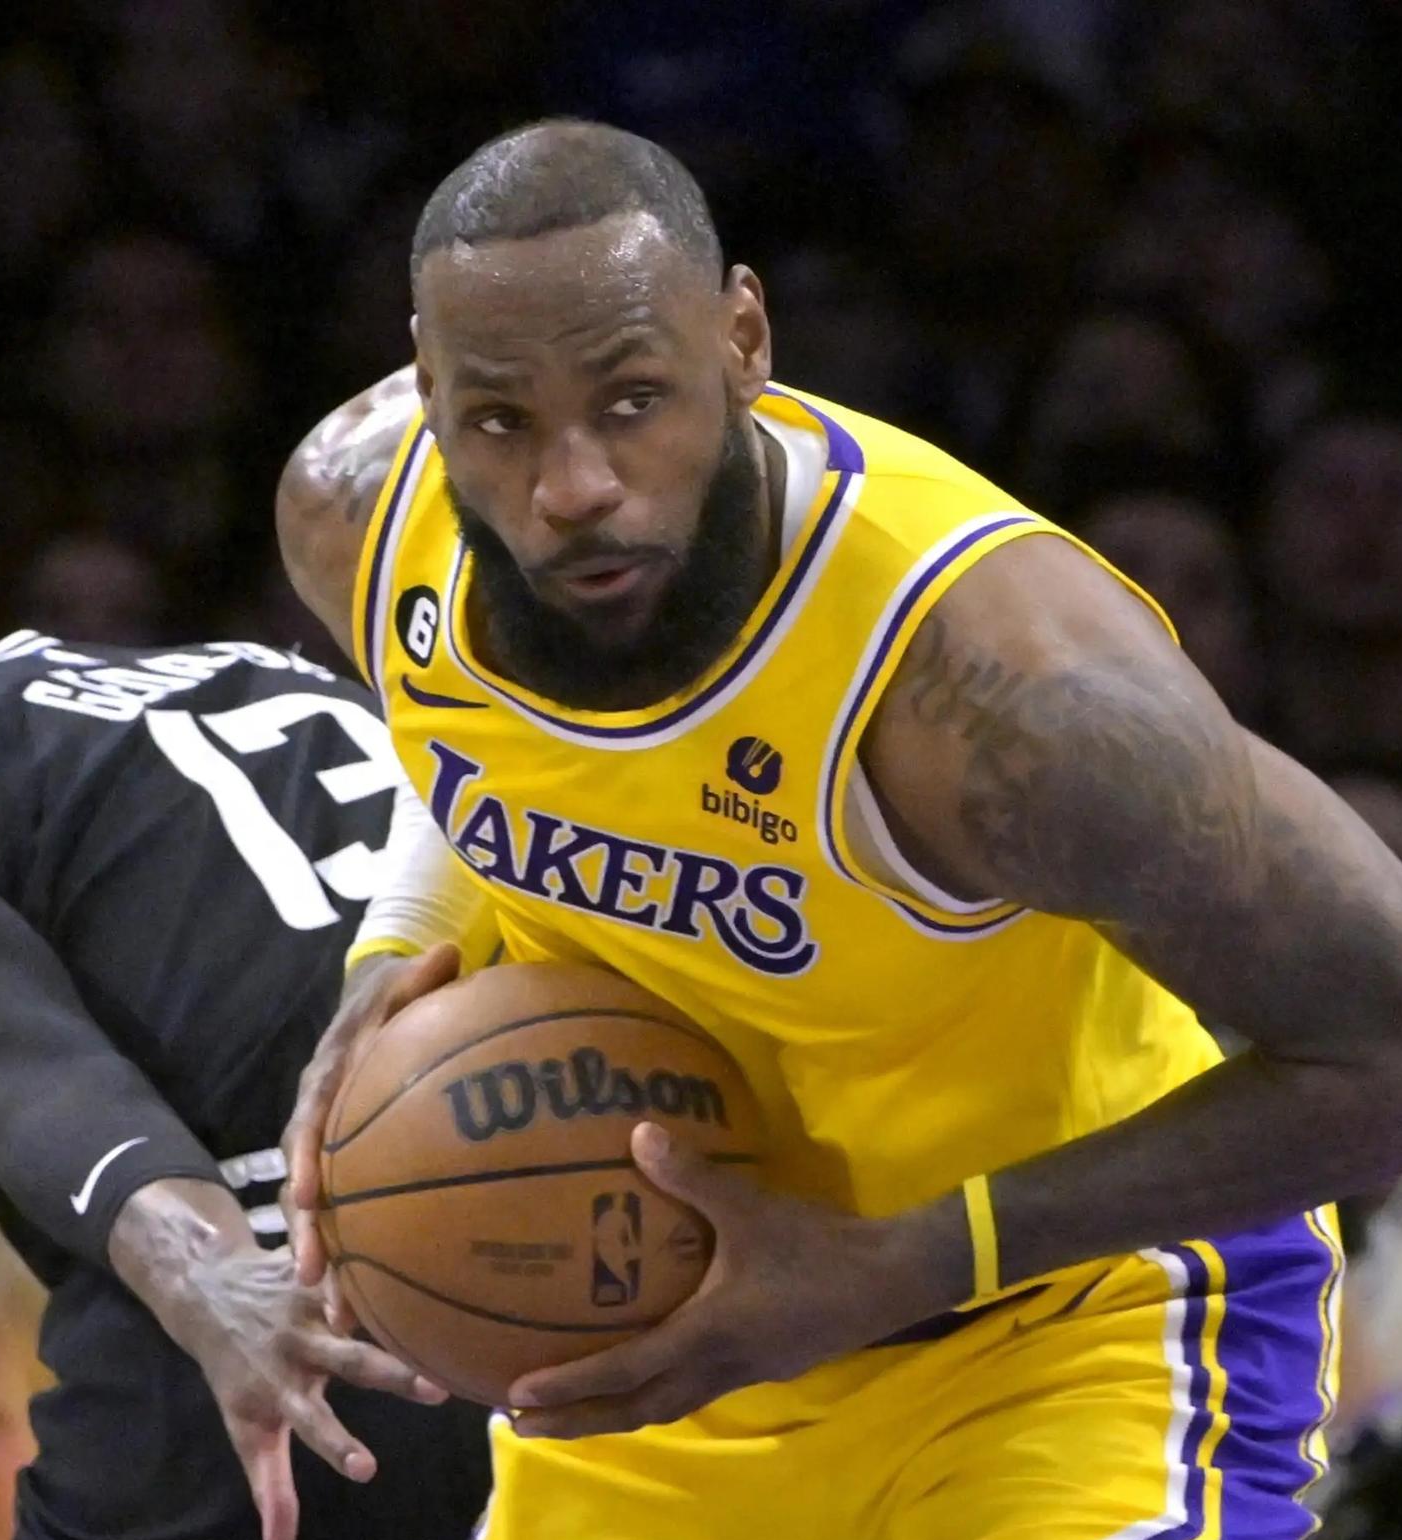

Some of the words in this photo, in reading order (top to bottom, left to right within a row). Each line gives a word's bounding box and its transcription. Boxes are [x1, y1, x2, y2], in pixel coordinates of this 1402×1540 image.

[406, 596, 438, 659] 6
[144, 692, 401, 931] 13
[429, 738, 820, 978] LAKERS
[701, 783, 798, 845] bibigo
[444, 1046, 730, 1141] Wilson
